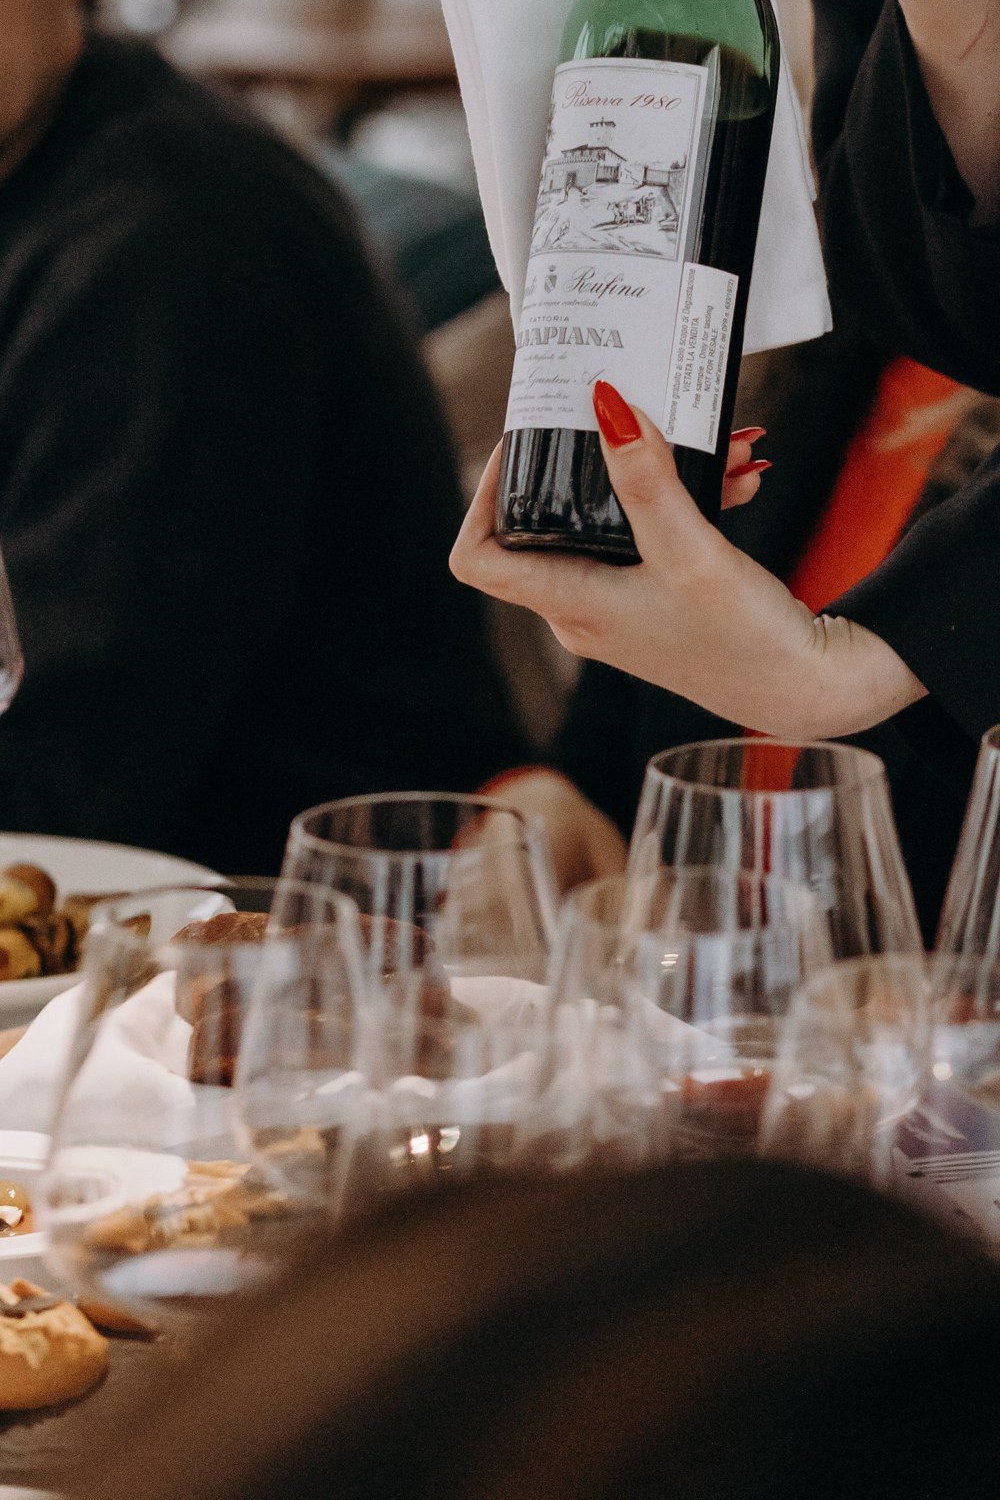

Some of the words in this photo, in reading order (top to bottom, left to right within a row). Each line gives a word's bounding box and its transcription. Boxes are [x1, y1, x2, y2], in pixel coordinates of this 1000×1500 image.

[562, 80, 624, 109] Riserva
[630, 94, 682, 110] 1980
[568, 266, 651, 298] Rufina
[682, 268, 696, 315] Degustazione
[683, 315, 690, 323] di
[704, 305, 714, 329] tasting
[680, 325, 689, 346] scopo
[689, 317, 700, 350] VENDITA
[708, 328, 718, 358] RESALE
[677, 347, 685, 362] solo
[687, 351, 695, 361] LA
[699, 343, 708, 359] Only
[682, 363, 693, 393] VIETATA
[696, 366, 705, 391] sample
[706, 359, 714, 374] FOR
[672, 371, 682, 399] gratuito
[704, 376, 712, 392] NOT
[692, 393, 701, 409] Free
[665, 400, 678, 436] Campione
